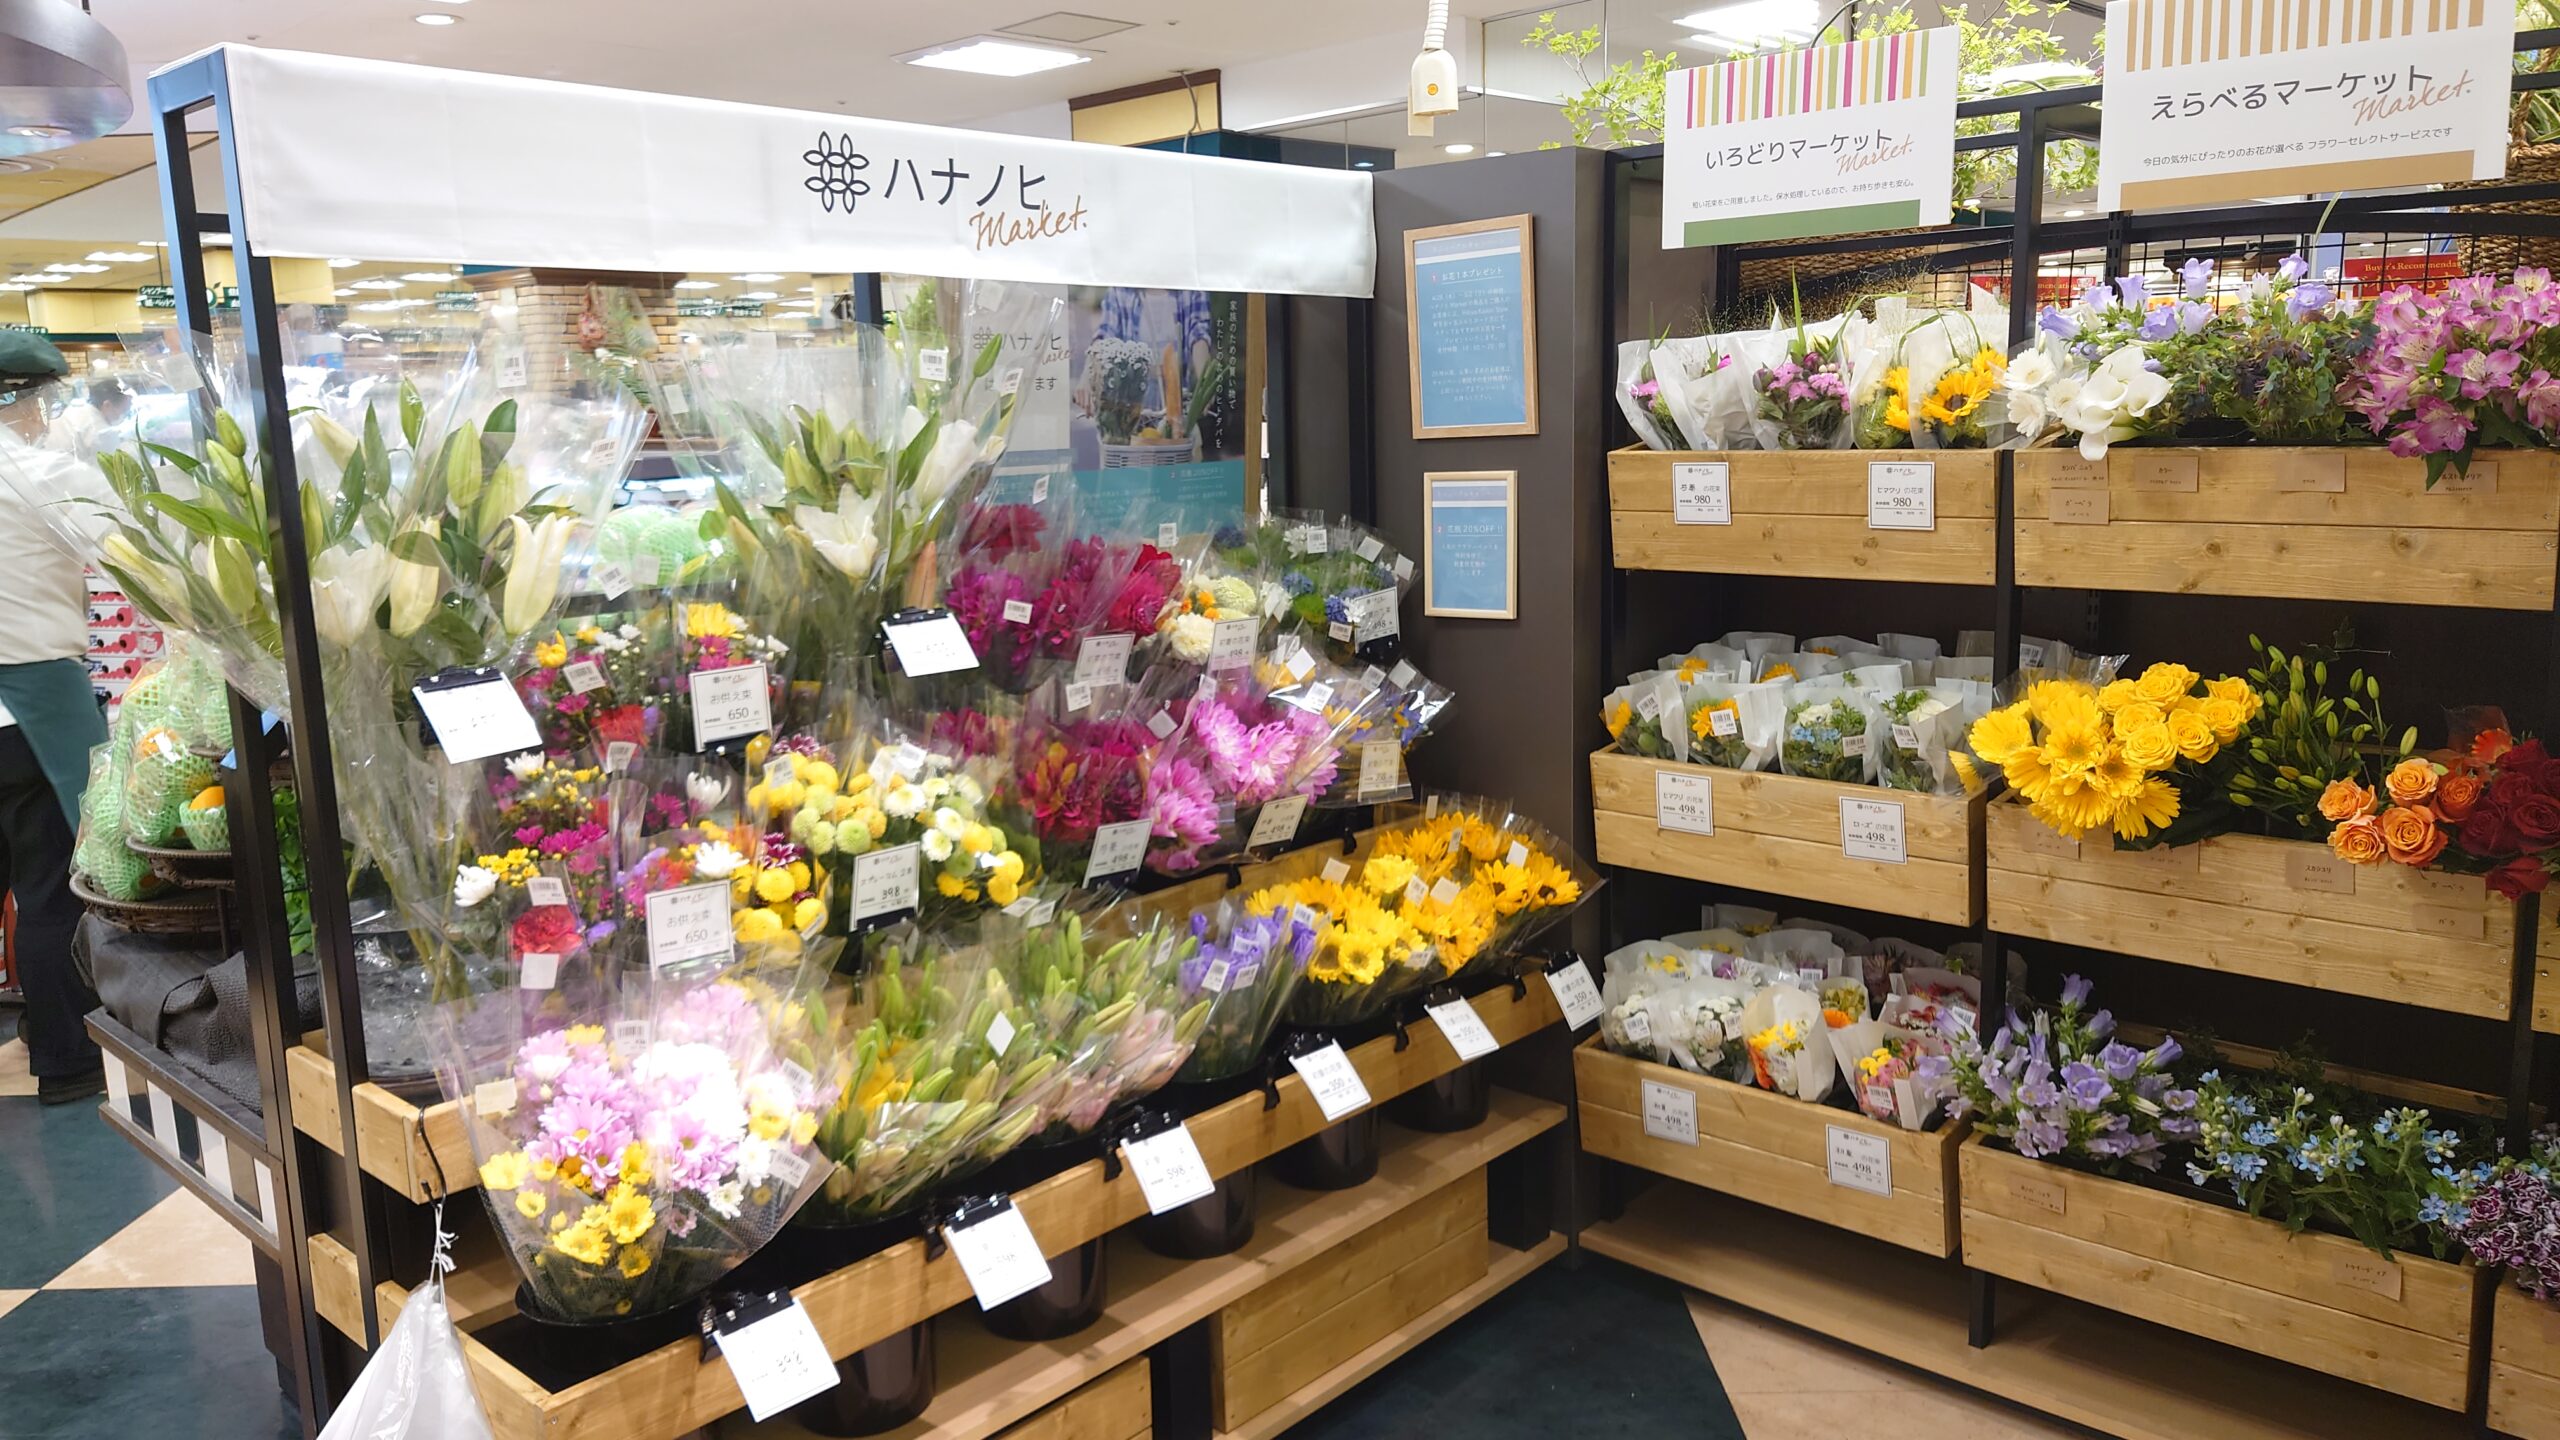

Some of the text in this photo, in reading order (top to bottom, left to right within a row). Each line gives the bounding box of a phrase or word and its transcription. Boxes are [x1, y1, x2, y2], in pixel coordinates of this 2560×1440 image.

[2151, 65, 2433, 121] えらべるマーケット
[1706, 129, 1893, 170] いろどりマーケット
[2143, 126, 2454, 167] 今日の気分にぴったりのお花が選べる フラワーセレクトサービスです
[884, 157, 1049, 211] ハナノヒ
[1877, 487, 1901, 495] ヒマワリ
[1693, 494, 1711, 505] 980
[1892, 497, 1912, 507] 980
[728, 706, 750, 721] 650
[1663, 792, 1684, 801] ヒマワリ
[1678, 803, 1696, 815] 498
[1865, 831, 1886, 843] 498
[881, 886, 901, 901] 398
[685, 928, 708, 944] 650
[1574, 991, 1588, 1004] 350
[1328, 1077, 1345, 1092] 350
[1664, 1114, 1682, 1126] 498
[1852, 1161, 1872, 1174] 498
